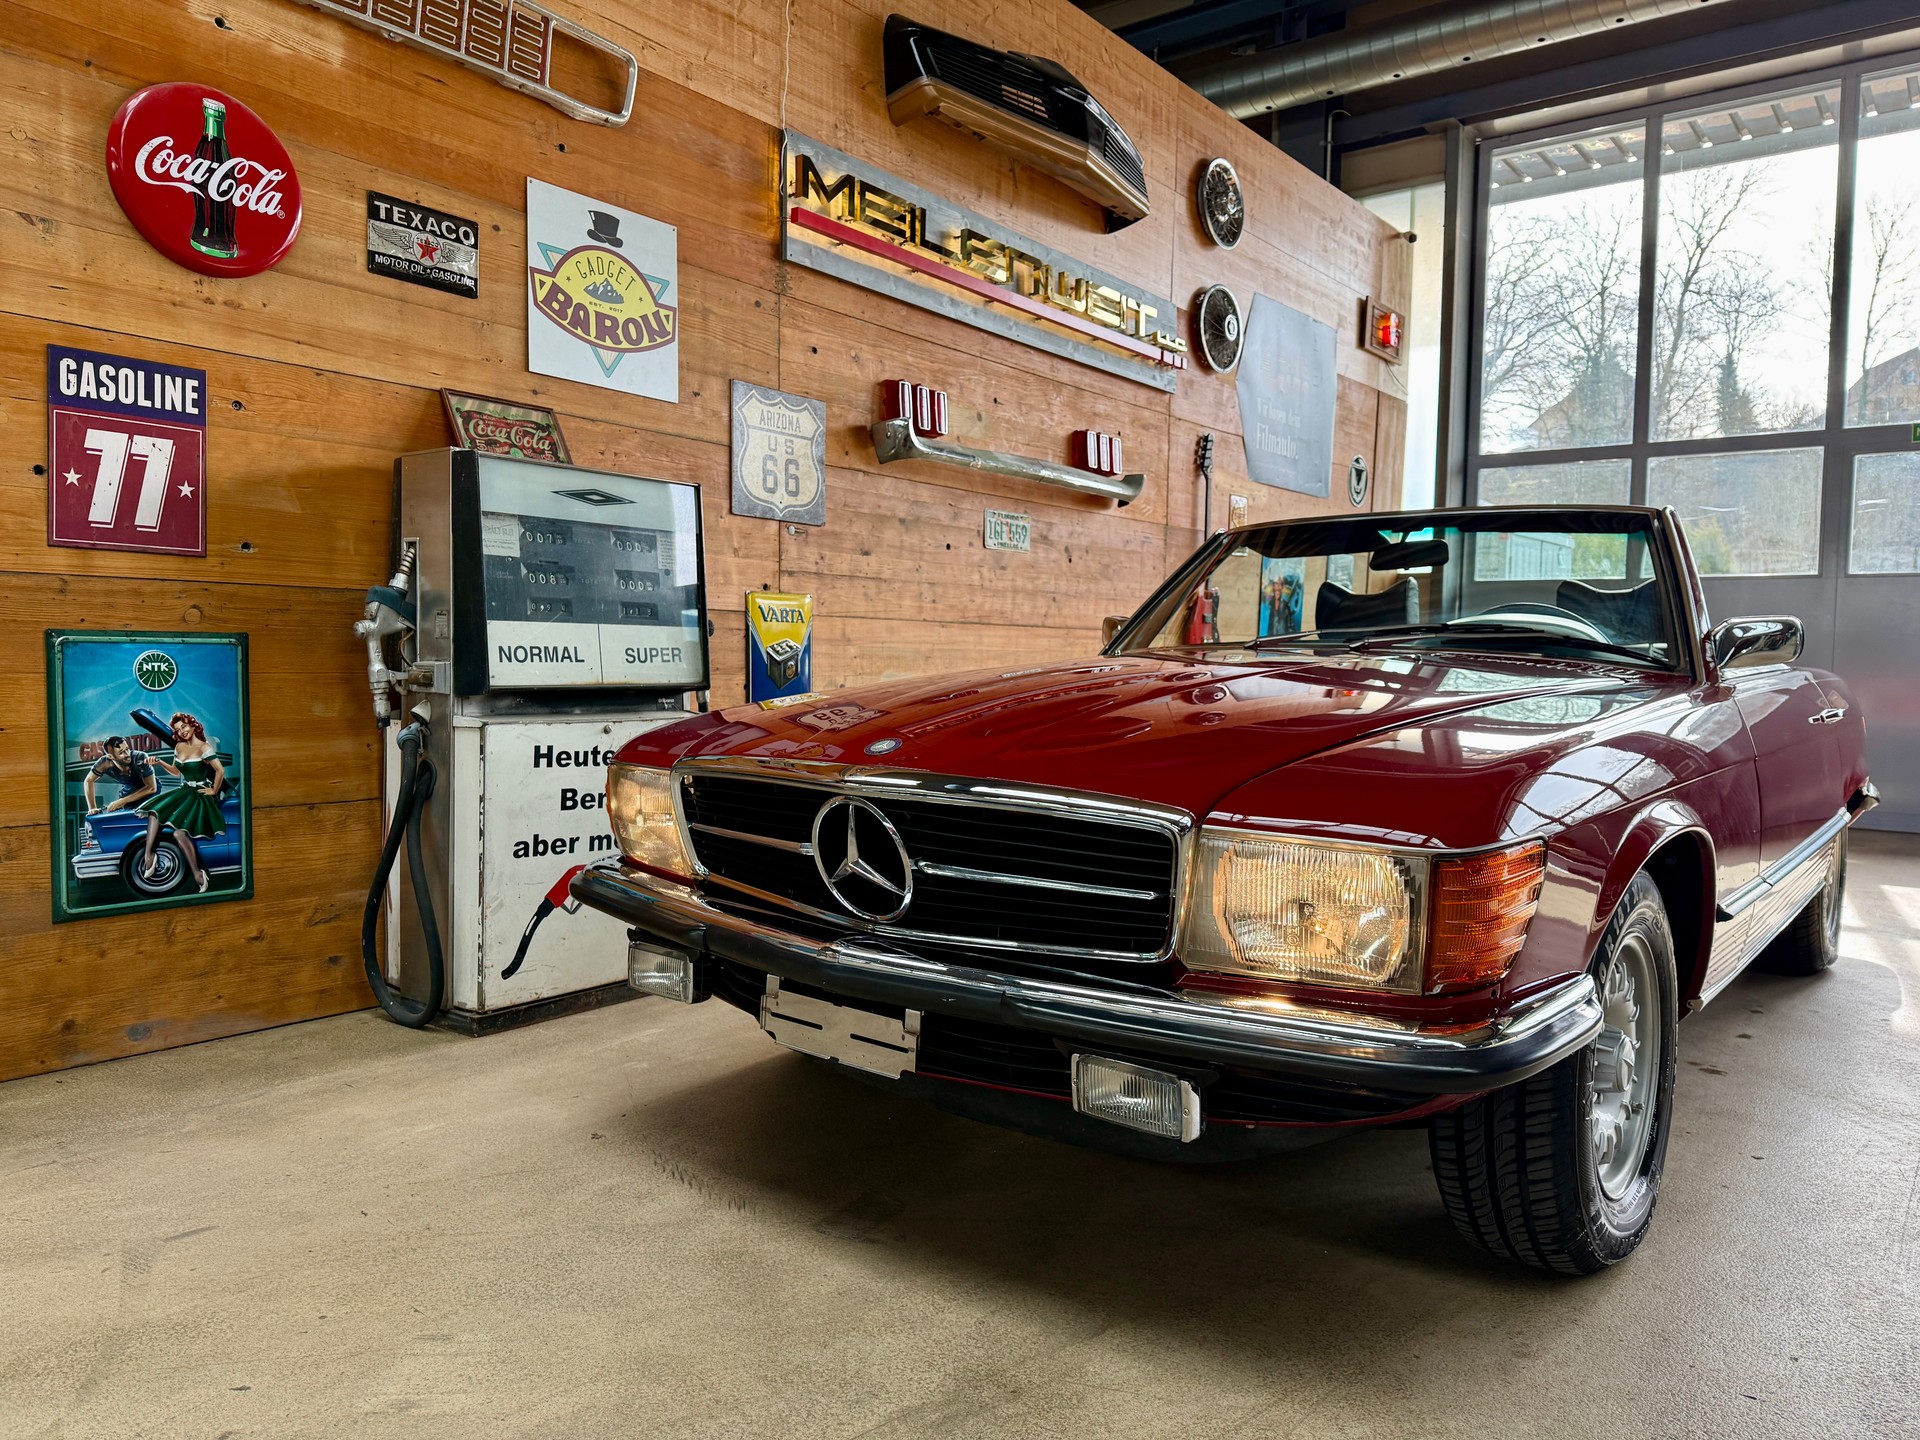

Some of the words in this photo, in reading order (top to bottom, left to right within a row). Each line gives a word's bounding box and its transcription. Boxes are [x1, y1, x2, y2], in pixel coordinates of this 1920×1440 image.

[135, 136, 287, 216] Coca-Cola
[374, 200, 475, 247] TEXACO
[374, 253, 409, 270] MOTOR
[411, 263, 426, 274] OIL
[431, 269, 475, 287] GASOLINE
[575, 256, 636, 291] GADGET
[539, 280, 671, 347] BARON
[59, 357, 199, 415] GASOLINE
[468, 418, 552, 451] Coca-Cola
[760, 409, 802, 433] ARIZONA
[84, 428, 176, 533] 77
[762, 454, 800, 498] 66
[758, 604, 806, 623] VARTA
[142, 662, 169, 672] NTK
[498, 645, 585, 663] NORMAL
[625, 647, 682, 664] SUPER
[533, 745, 615, 768] Heute
[512, 834, 580, 859] aber
[589, 834, 620, 852] m
